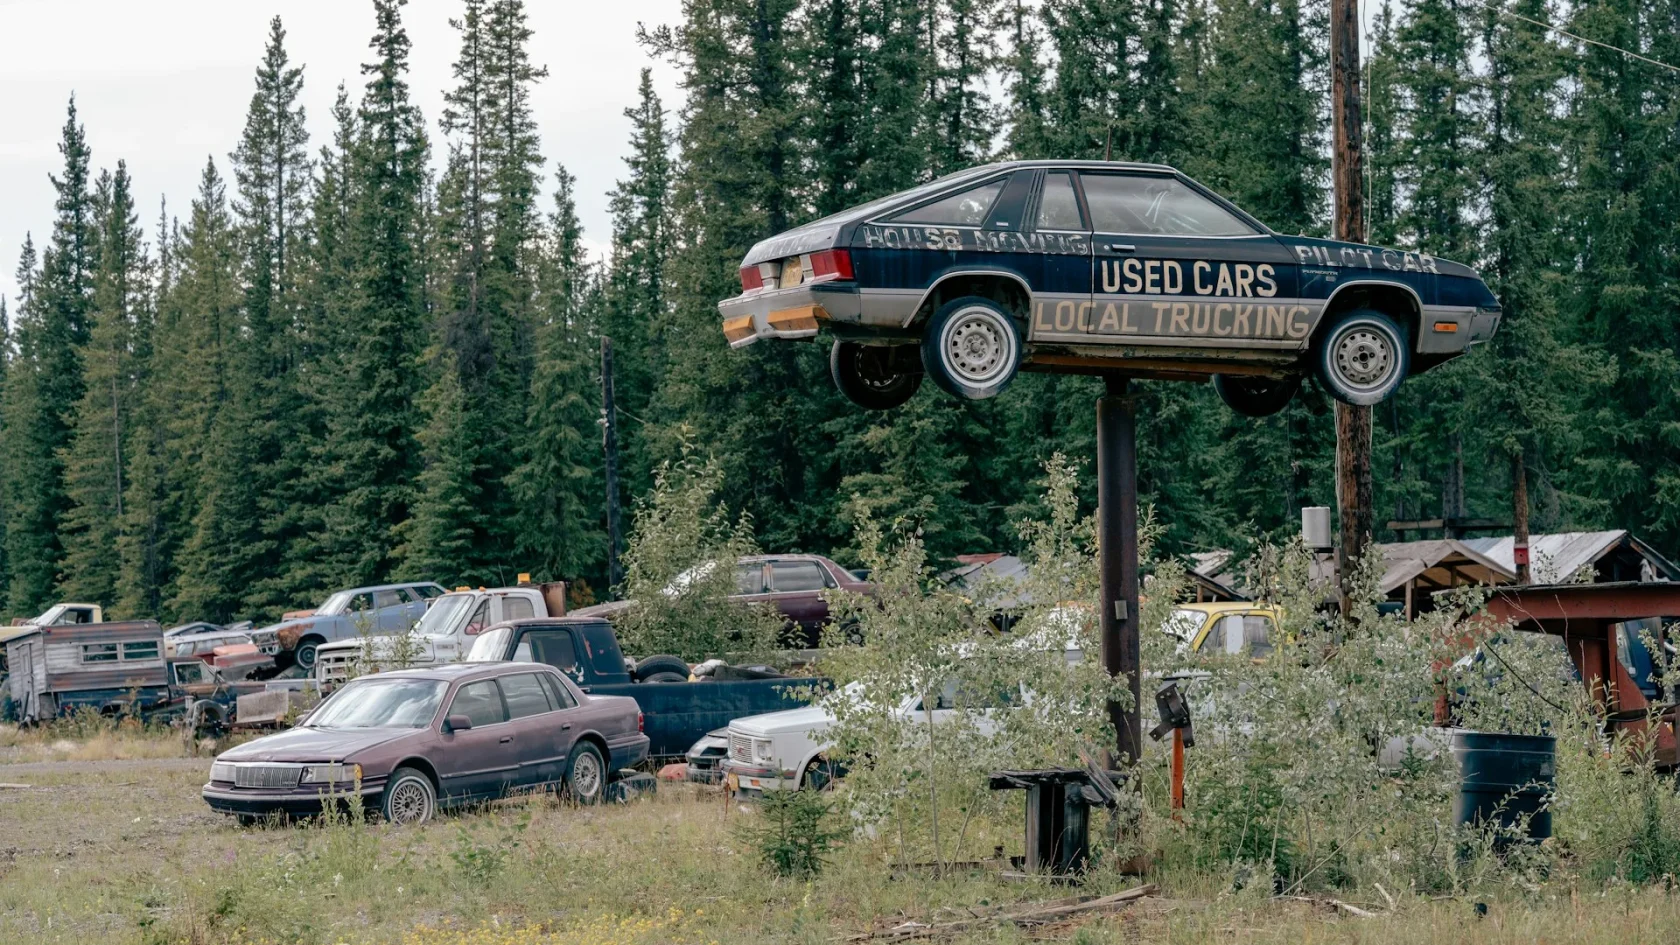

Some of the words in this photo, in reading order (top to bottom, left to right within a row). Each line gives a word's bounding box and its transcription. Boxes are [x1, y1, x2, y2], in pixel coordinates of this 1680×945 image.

[1101, 257, 1184, 294] USED
[1194, 261, 1279, 298] CARS
[1294, 245, 1374, 269] PILOT
[1380, 249, 1443, 275] CAR
[1034, 301, 1139, 333] LOCAL
[1151, 302, 1310, 338] TRUCKING
